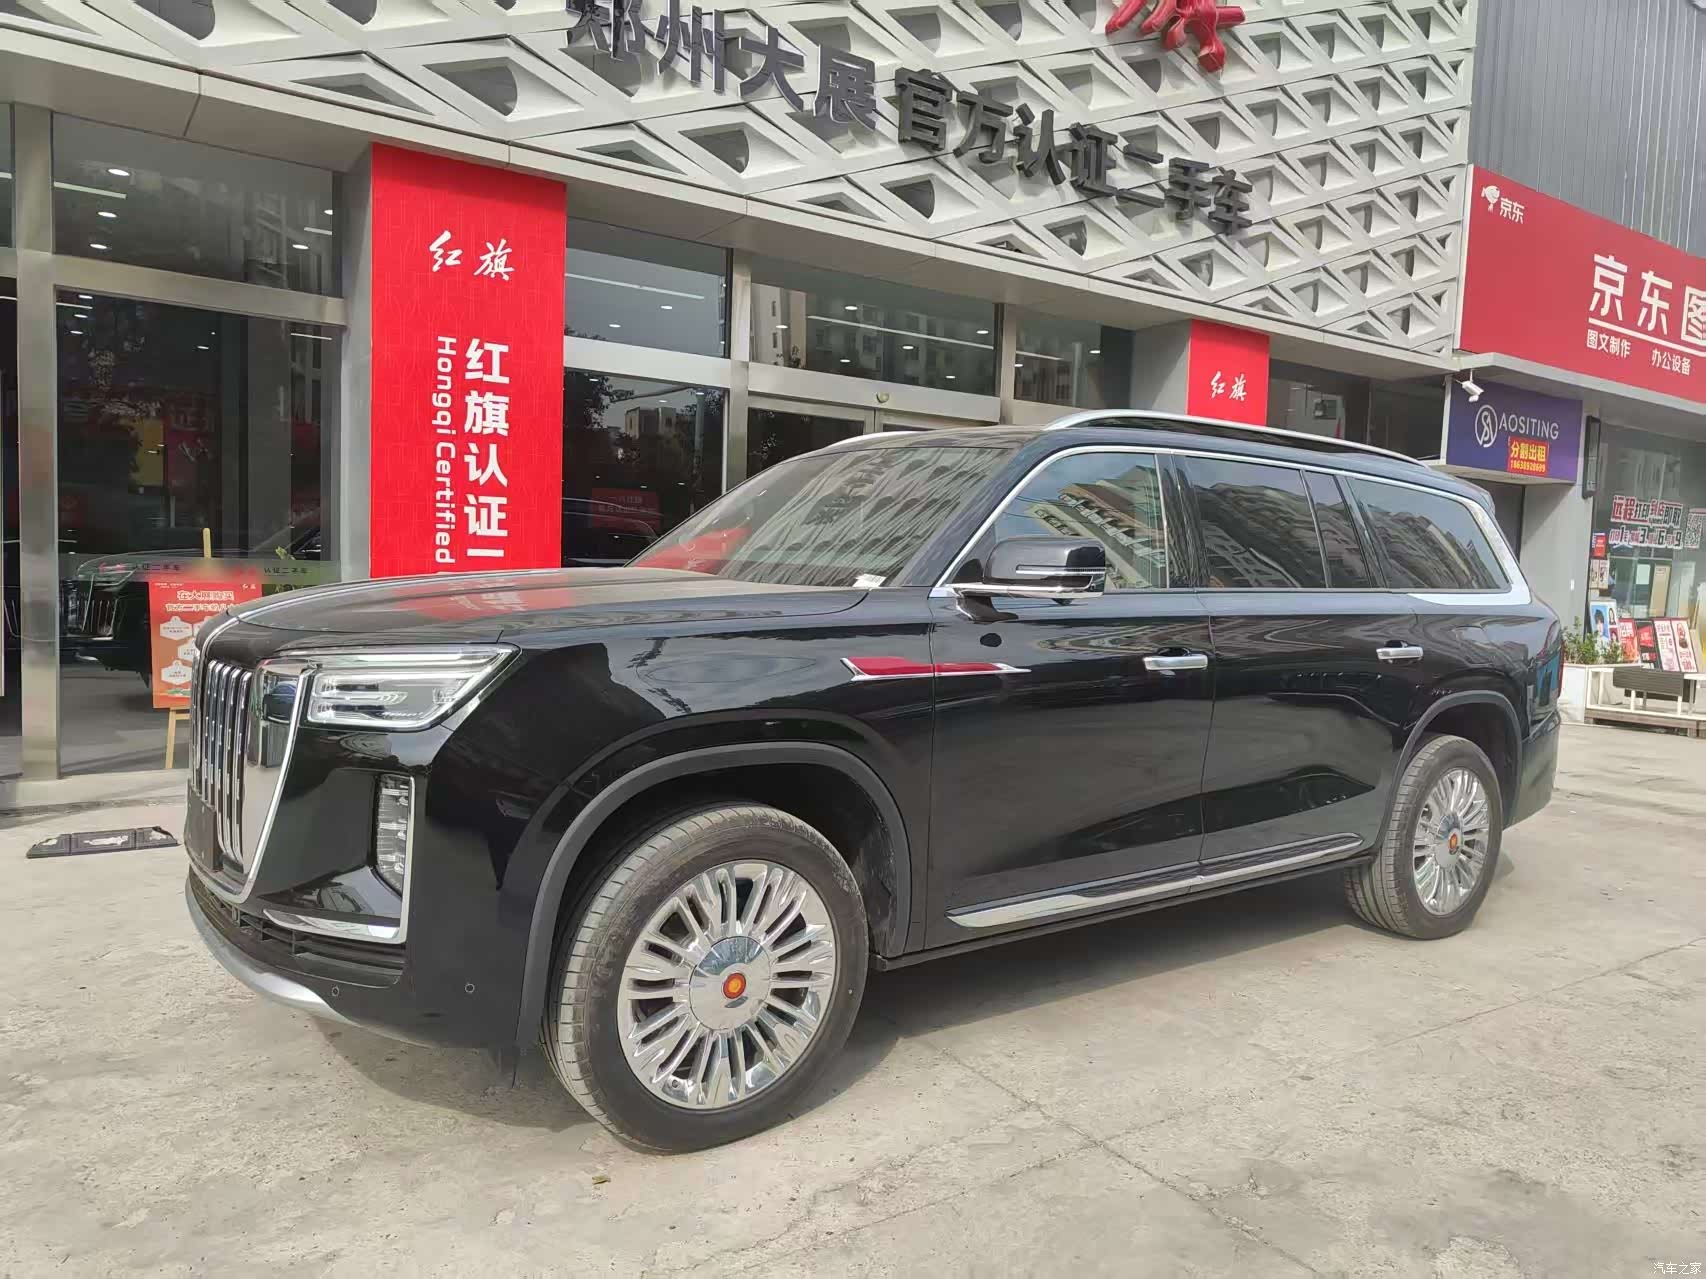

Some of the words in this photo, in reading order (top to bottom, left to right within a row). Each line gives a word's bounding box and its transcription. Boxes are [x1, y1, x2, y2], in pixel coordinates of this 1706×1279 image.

[1500, 197, 1526, 224] 京东
[430, 230, 515, 281] 红旗
[1587, 329, 1632, 359] 图文制作
[1652, 348, 1692, 376] 办公设备
[431, 336, 457, 434] Hongqi
[1210, 371, 1247, 401] 红旗
[1499, 412, 1560, 440] AOSITING
[435, 442, 457, 564] Certified
